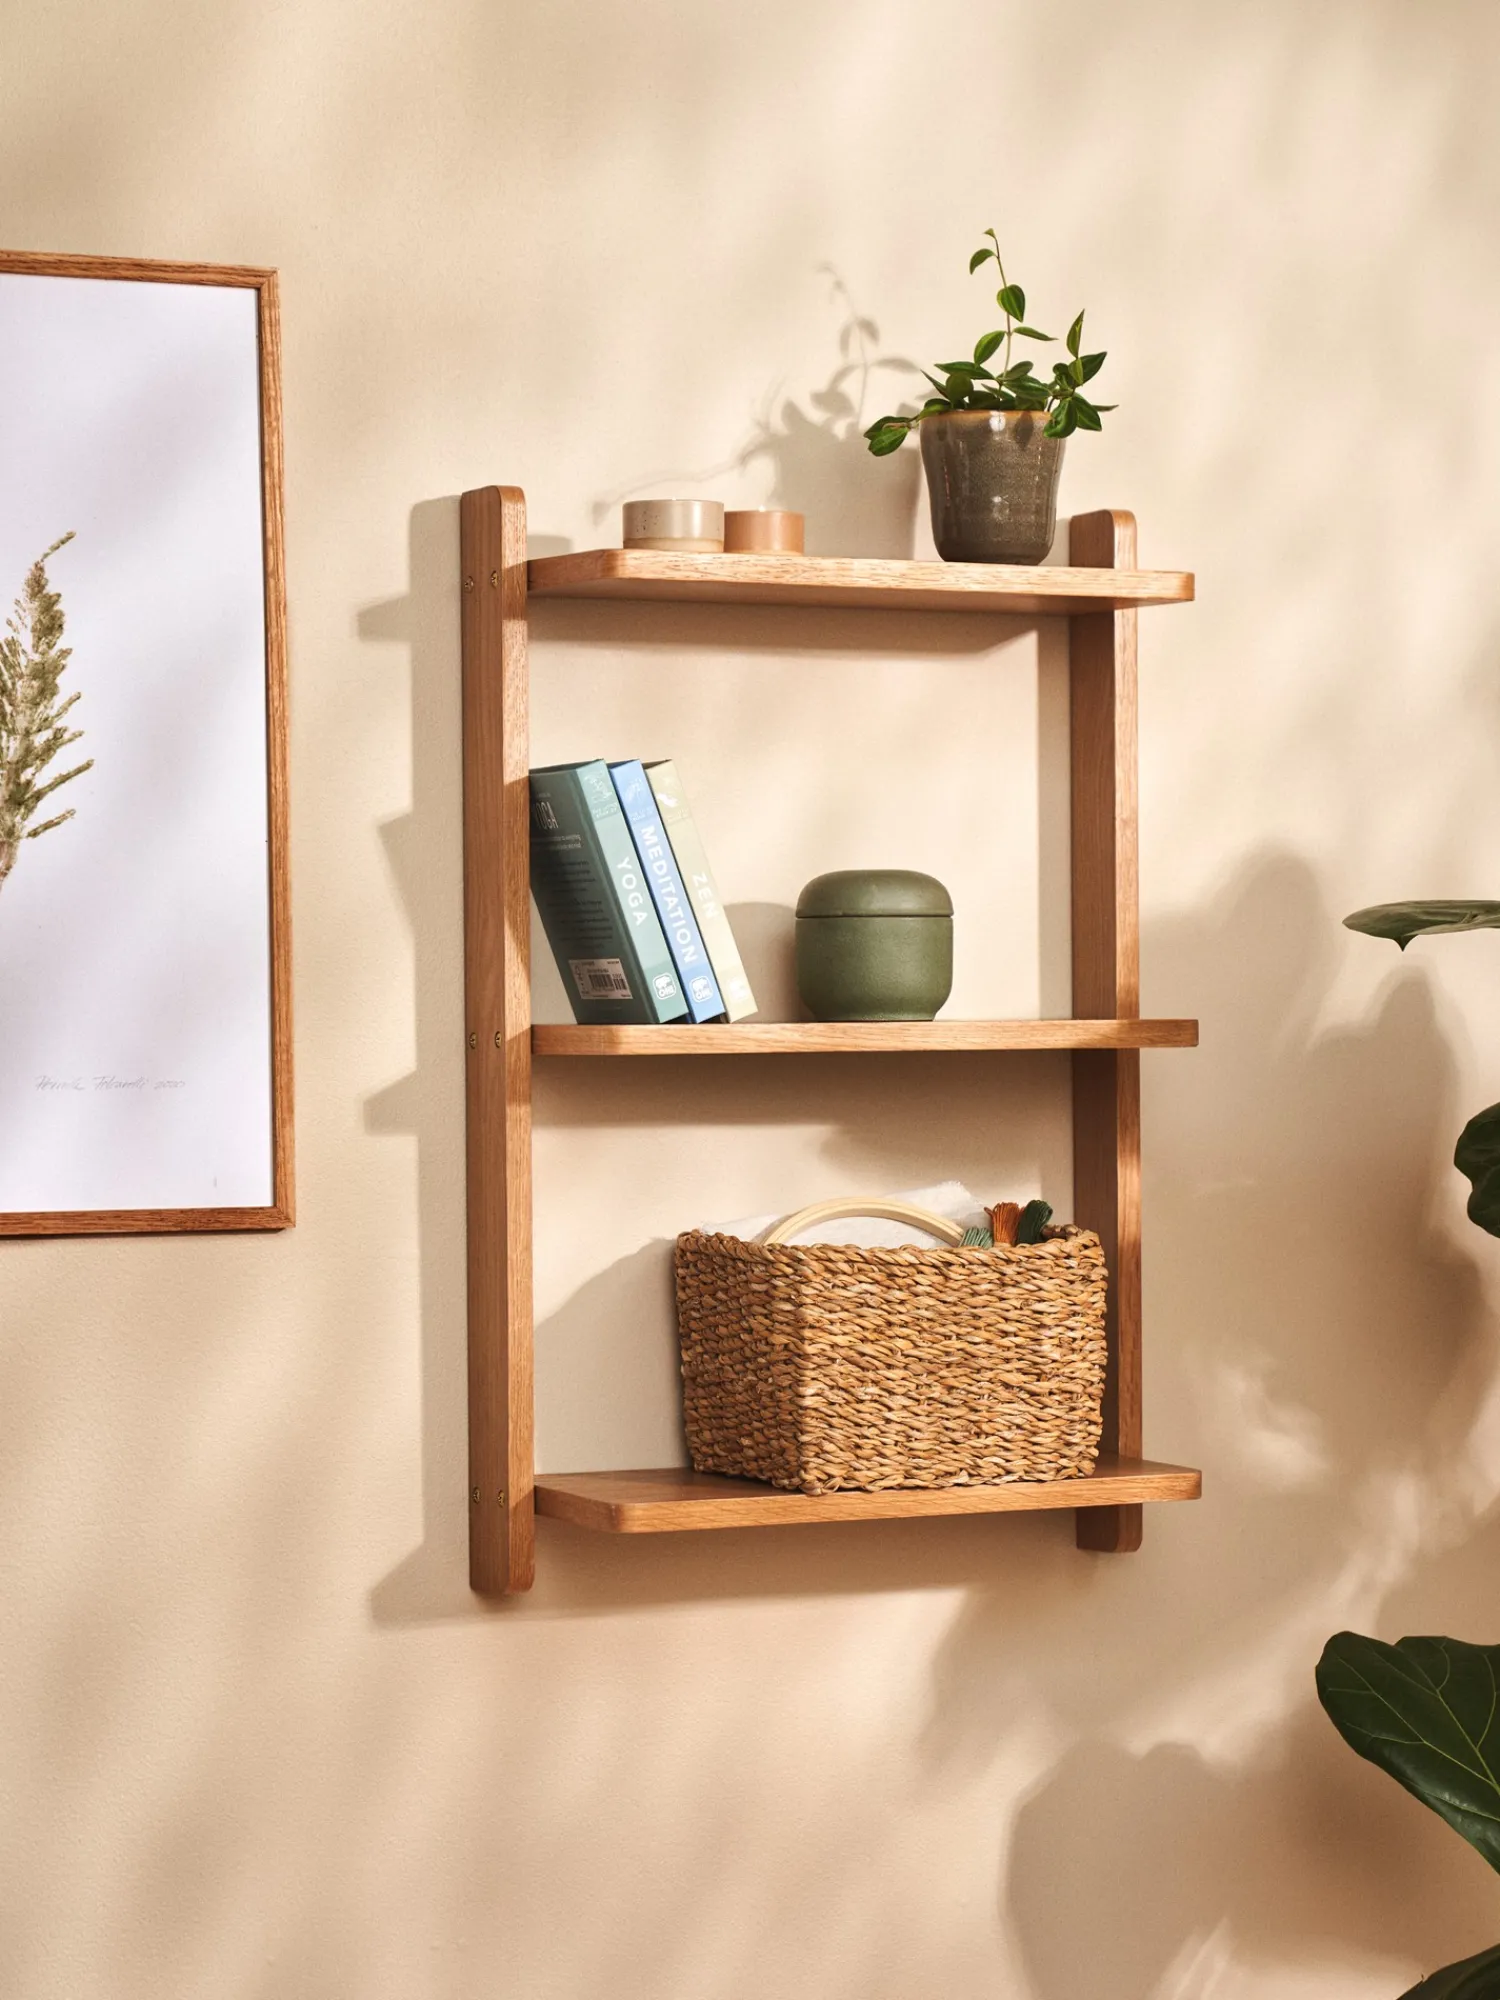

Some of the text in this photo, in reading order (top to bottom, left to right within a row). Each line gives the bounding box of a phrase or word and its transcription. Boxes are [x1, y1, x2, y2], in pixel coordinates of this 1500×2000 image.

[616, 857, 648, 926] YOGA
[641, 825, 698, 963] MEDITATION
[692, 871, 719, 919] ZEN
